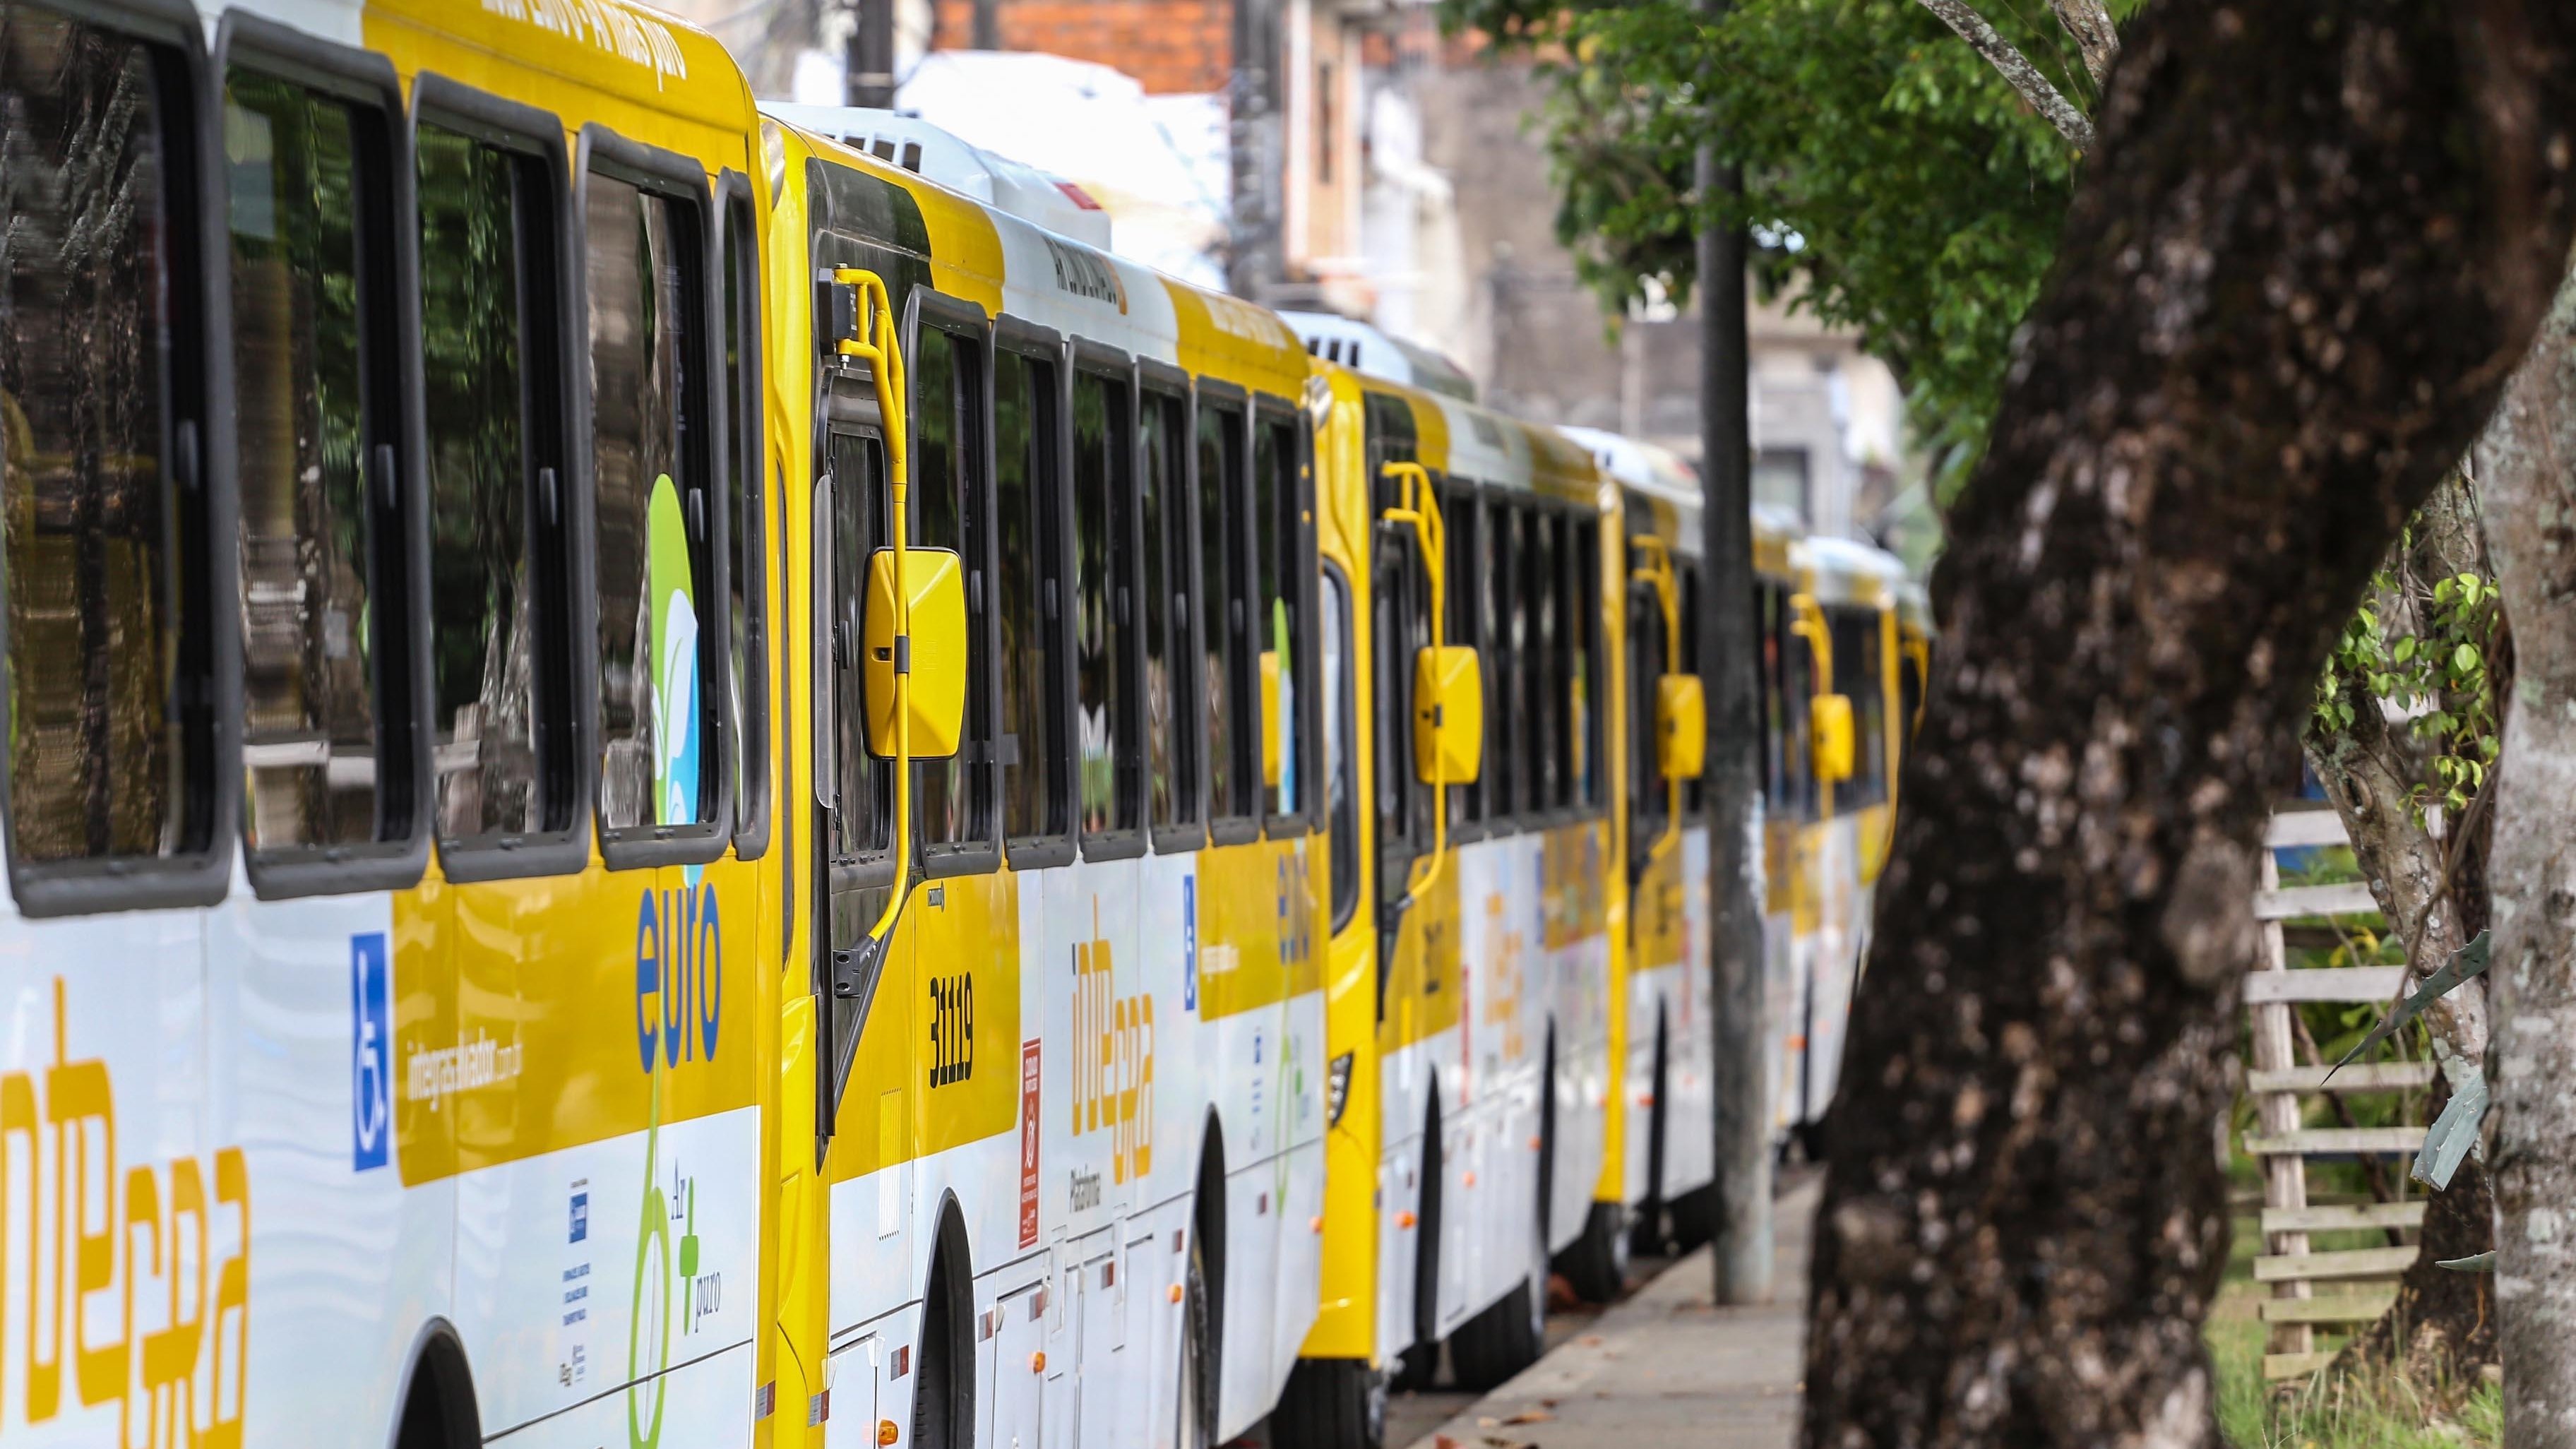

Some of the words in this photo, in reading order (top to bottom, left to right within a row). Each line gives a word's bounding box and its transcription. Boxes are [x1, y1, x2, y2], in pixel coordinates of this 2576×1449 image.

[636, 883, 721, 1074] euro
[929, 971, 973, 1089] 31119
[670, 1157, 686, 1220] Ar
[694, 1270, 722, 1334] puro
